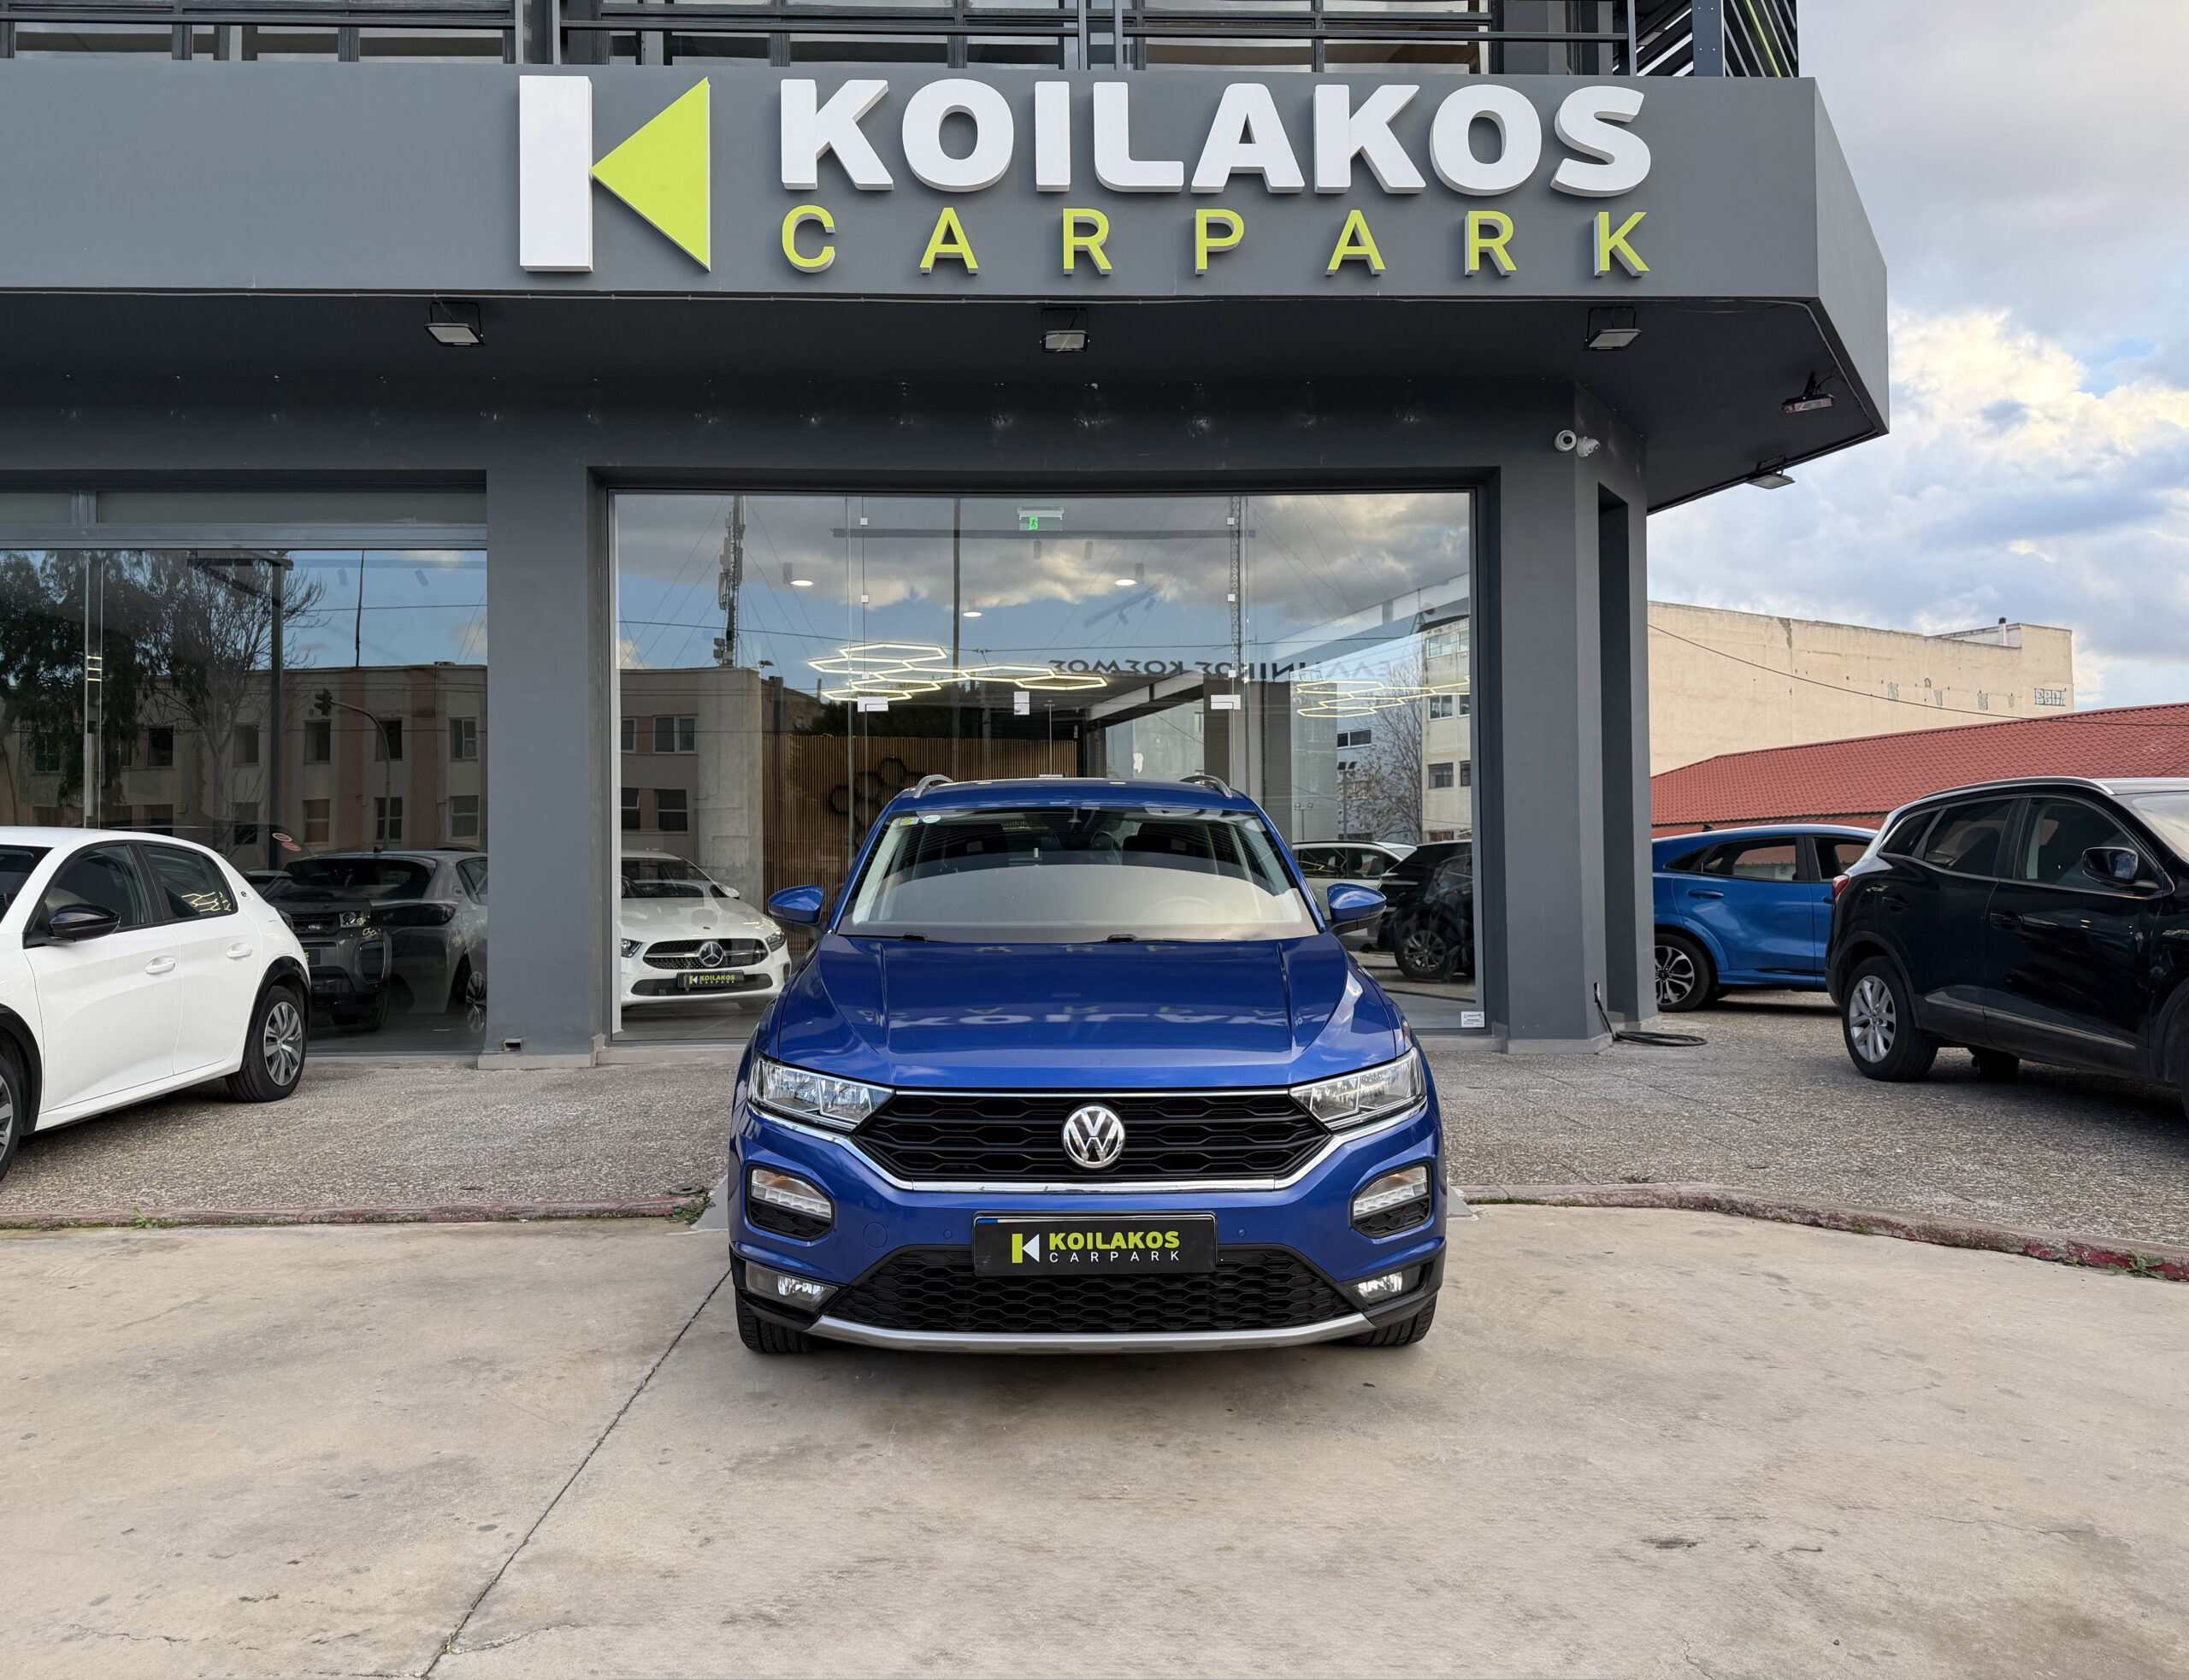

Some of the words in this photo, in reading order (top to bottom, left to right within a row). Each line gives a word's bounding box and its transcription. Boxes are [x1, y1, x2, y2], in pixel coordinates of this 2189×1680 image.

[780, 78, 1651, 197] KOILAKOS
[781, 204, 1651, 278] CARPARK
[1048, 1231, 1180, 1251] KOILAKOS
[1048, 1250, 1180, 1263] CARPARK
